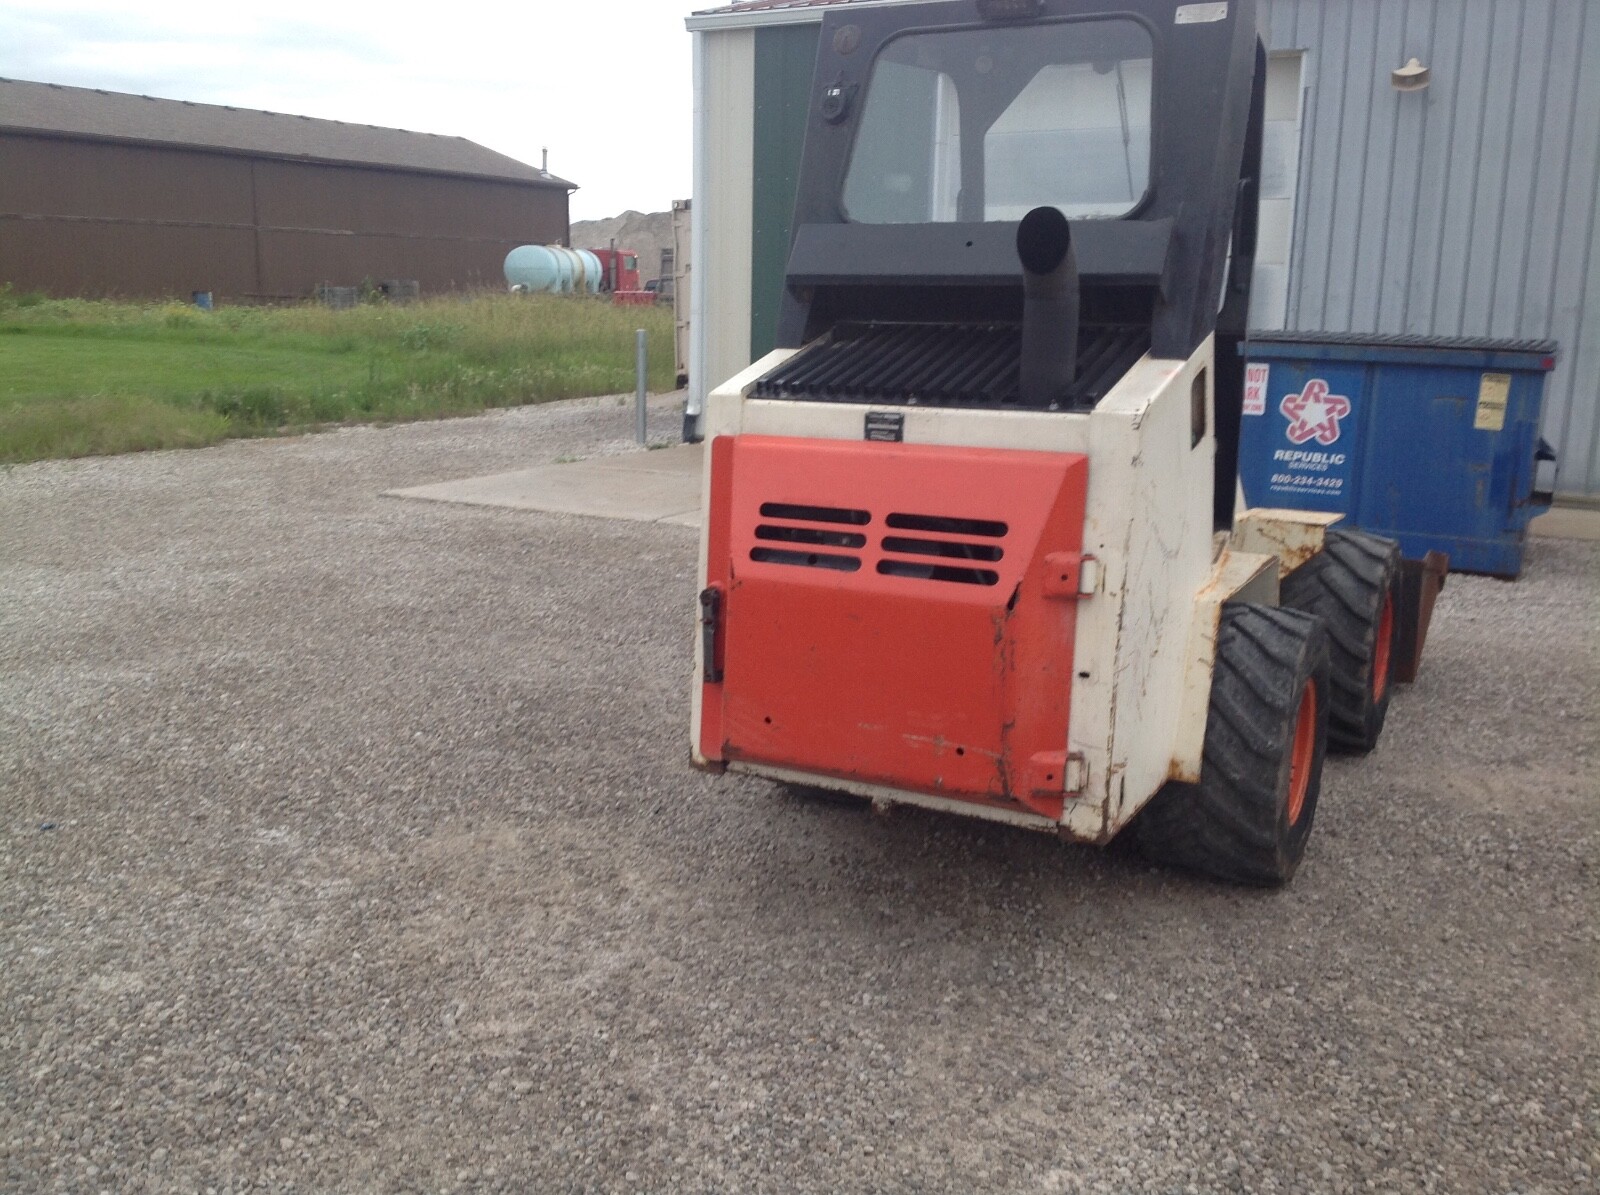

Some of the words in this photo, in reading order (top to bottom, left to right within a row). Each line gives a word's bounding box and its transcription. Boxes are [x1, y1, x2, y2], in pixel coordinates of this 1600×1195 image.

[1248, 368, 1267, 382] NOT
[1273, 449, 1346, 465] REPUBLIC
[1288, 461, 1329, 471] SERVICES
[1270, 473, 1344, 489] 800-234-3429
